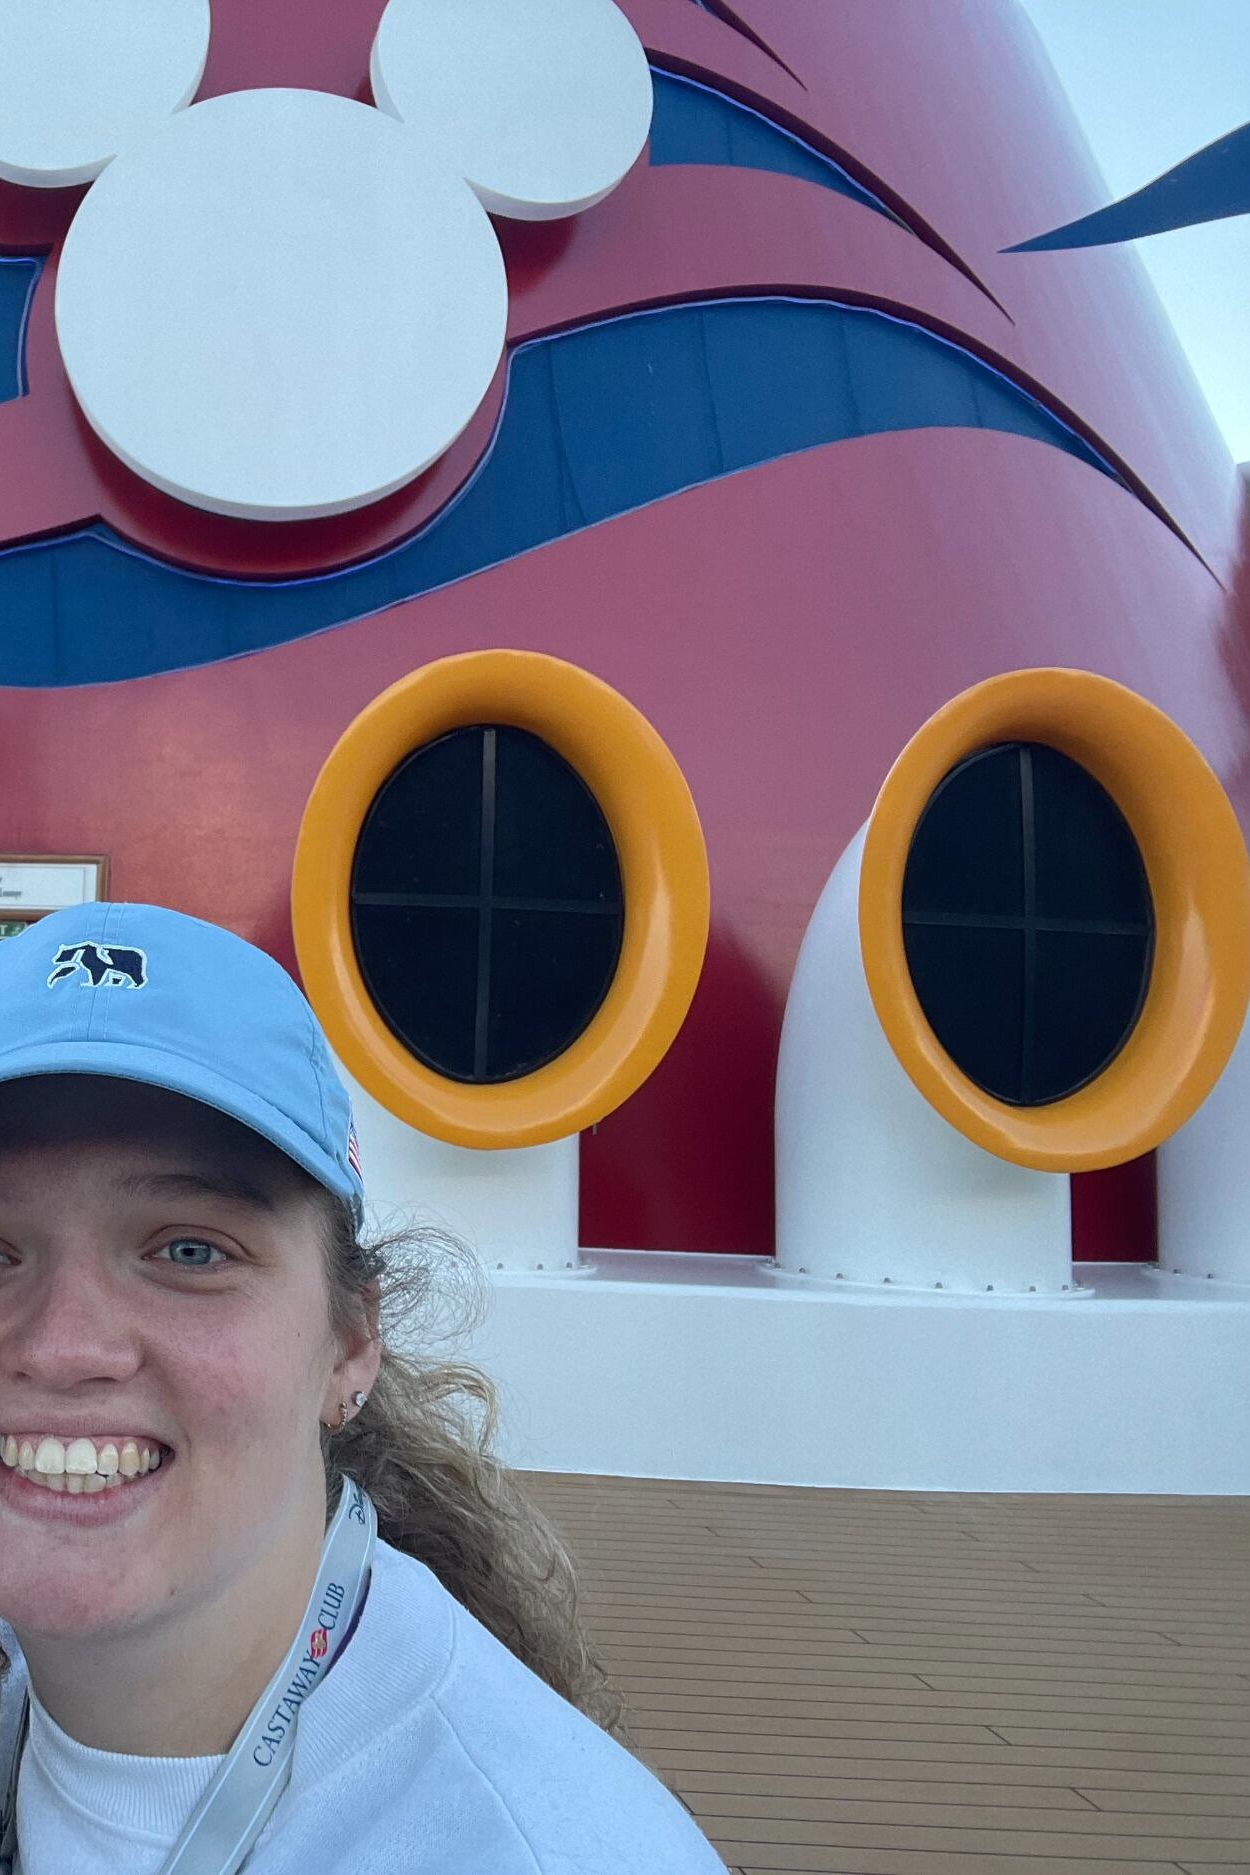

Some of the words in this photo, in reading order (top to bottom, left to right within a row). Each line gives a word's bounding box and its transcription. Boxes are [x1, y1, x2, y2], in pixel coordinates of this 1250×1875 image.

[0, 887, 22, 899] Lounge
[253, 1649, 321, 1767] CASTAWAY
[318, 1582, 345, 1631] CLUB
